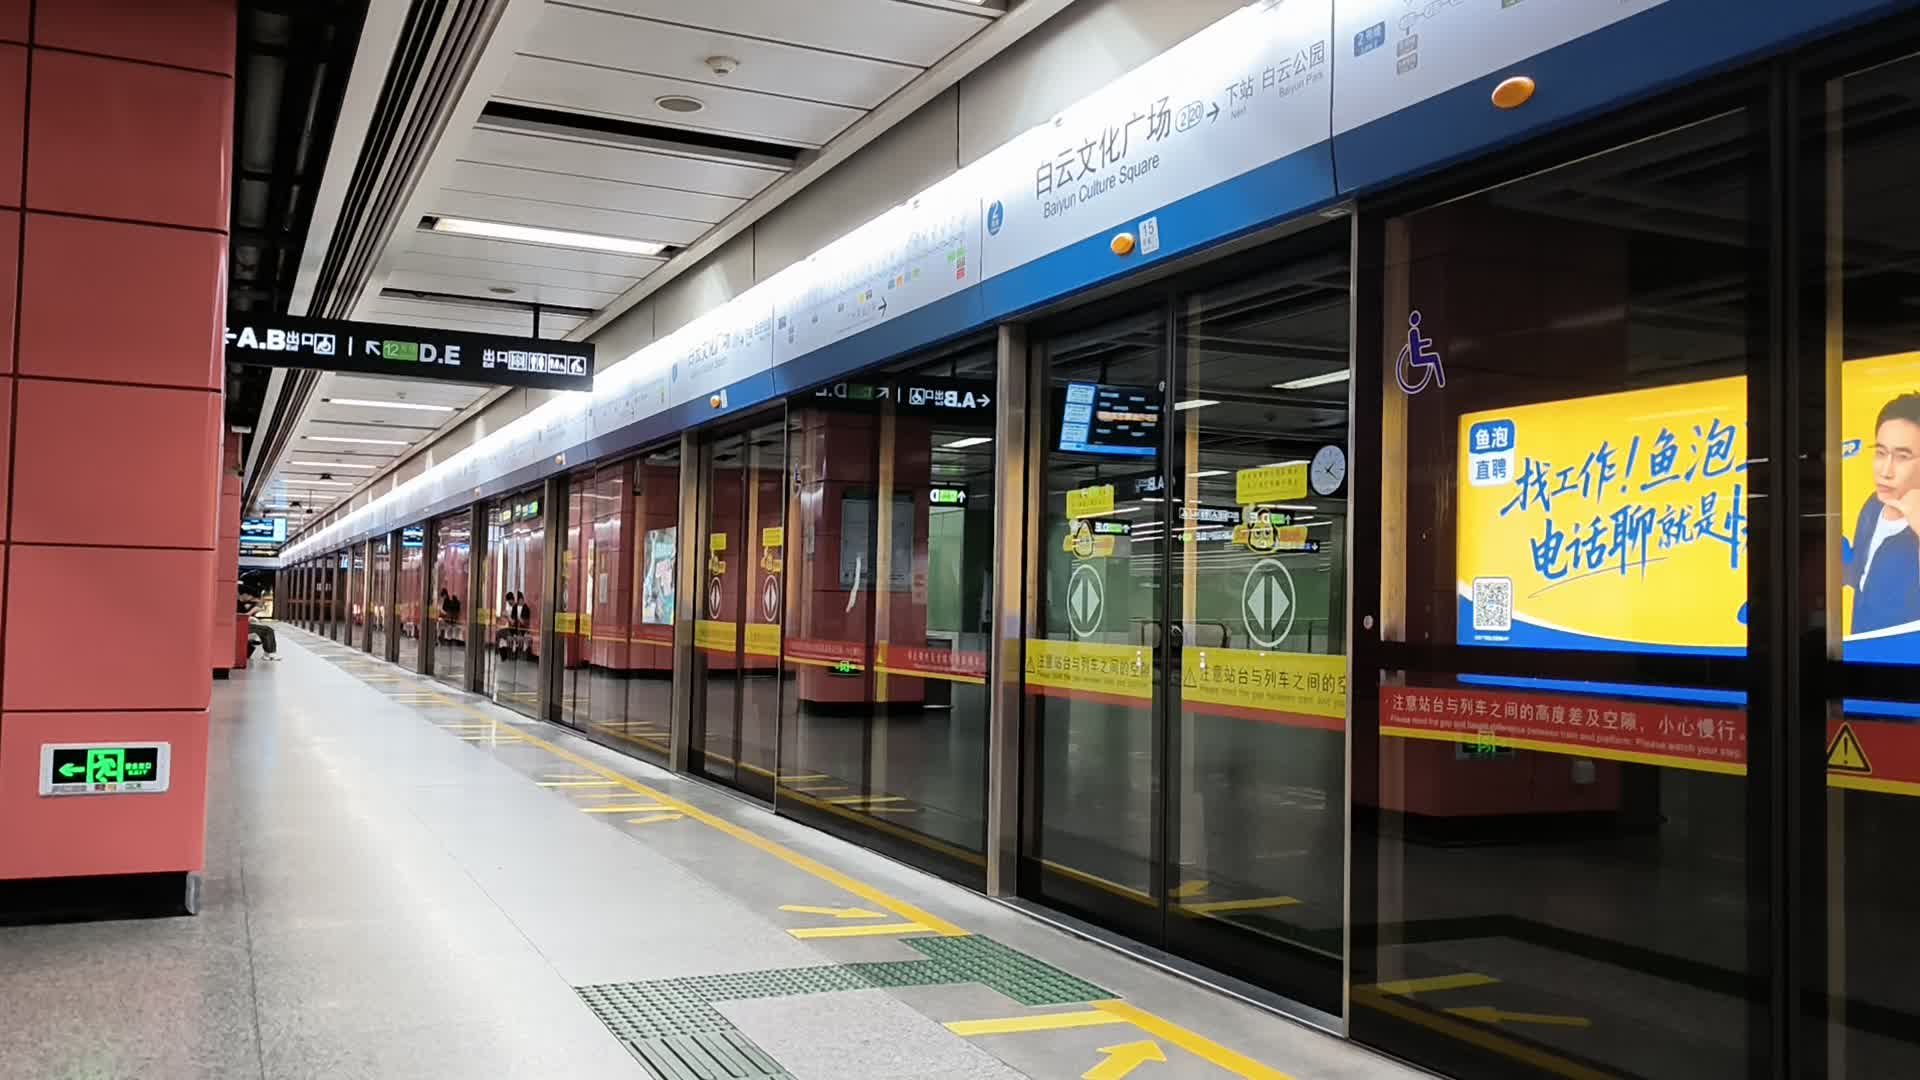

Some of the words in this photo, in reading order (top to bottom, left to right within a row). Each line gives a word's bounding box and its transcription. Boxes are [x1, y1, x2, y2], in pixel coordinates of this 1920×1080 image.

[1262, 40, 1325, 91] 白云公园
[1225, 76, 1254, 106] 下站
[1036, 95, 1171, 200] 白云文化广场
[1043, 192, 1077, 219] Baiyun
[1079, 174, 1116, 204] Culture
[1119, 153, 1160, 186] Square
[419, 343, 461, 366] D.E
[1475, 426, 1508, 450] 鱼泡
[1475, 458, 1506, 480] 直聘
[1500, 417, 1748, 517] 找工作！鱼泡
